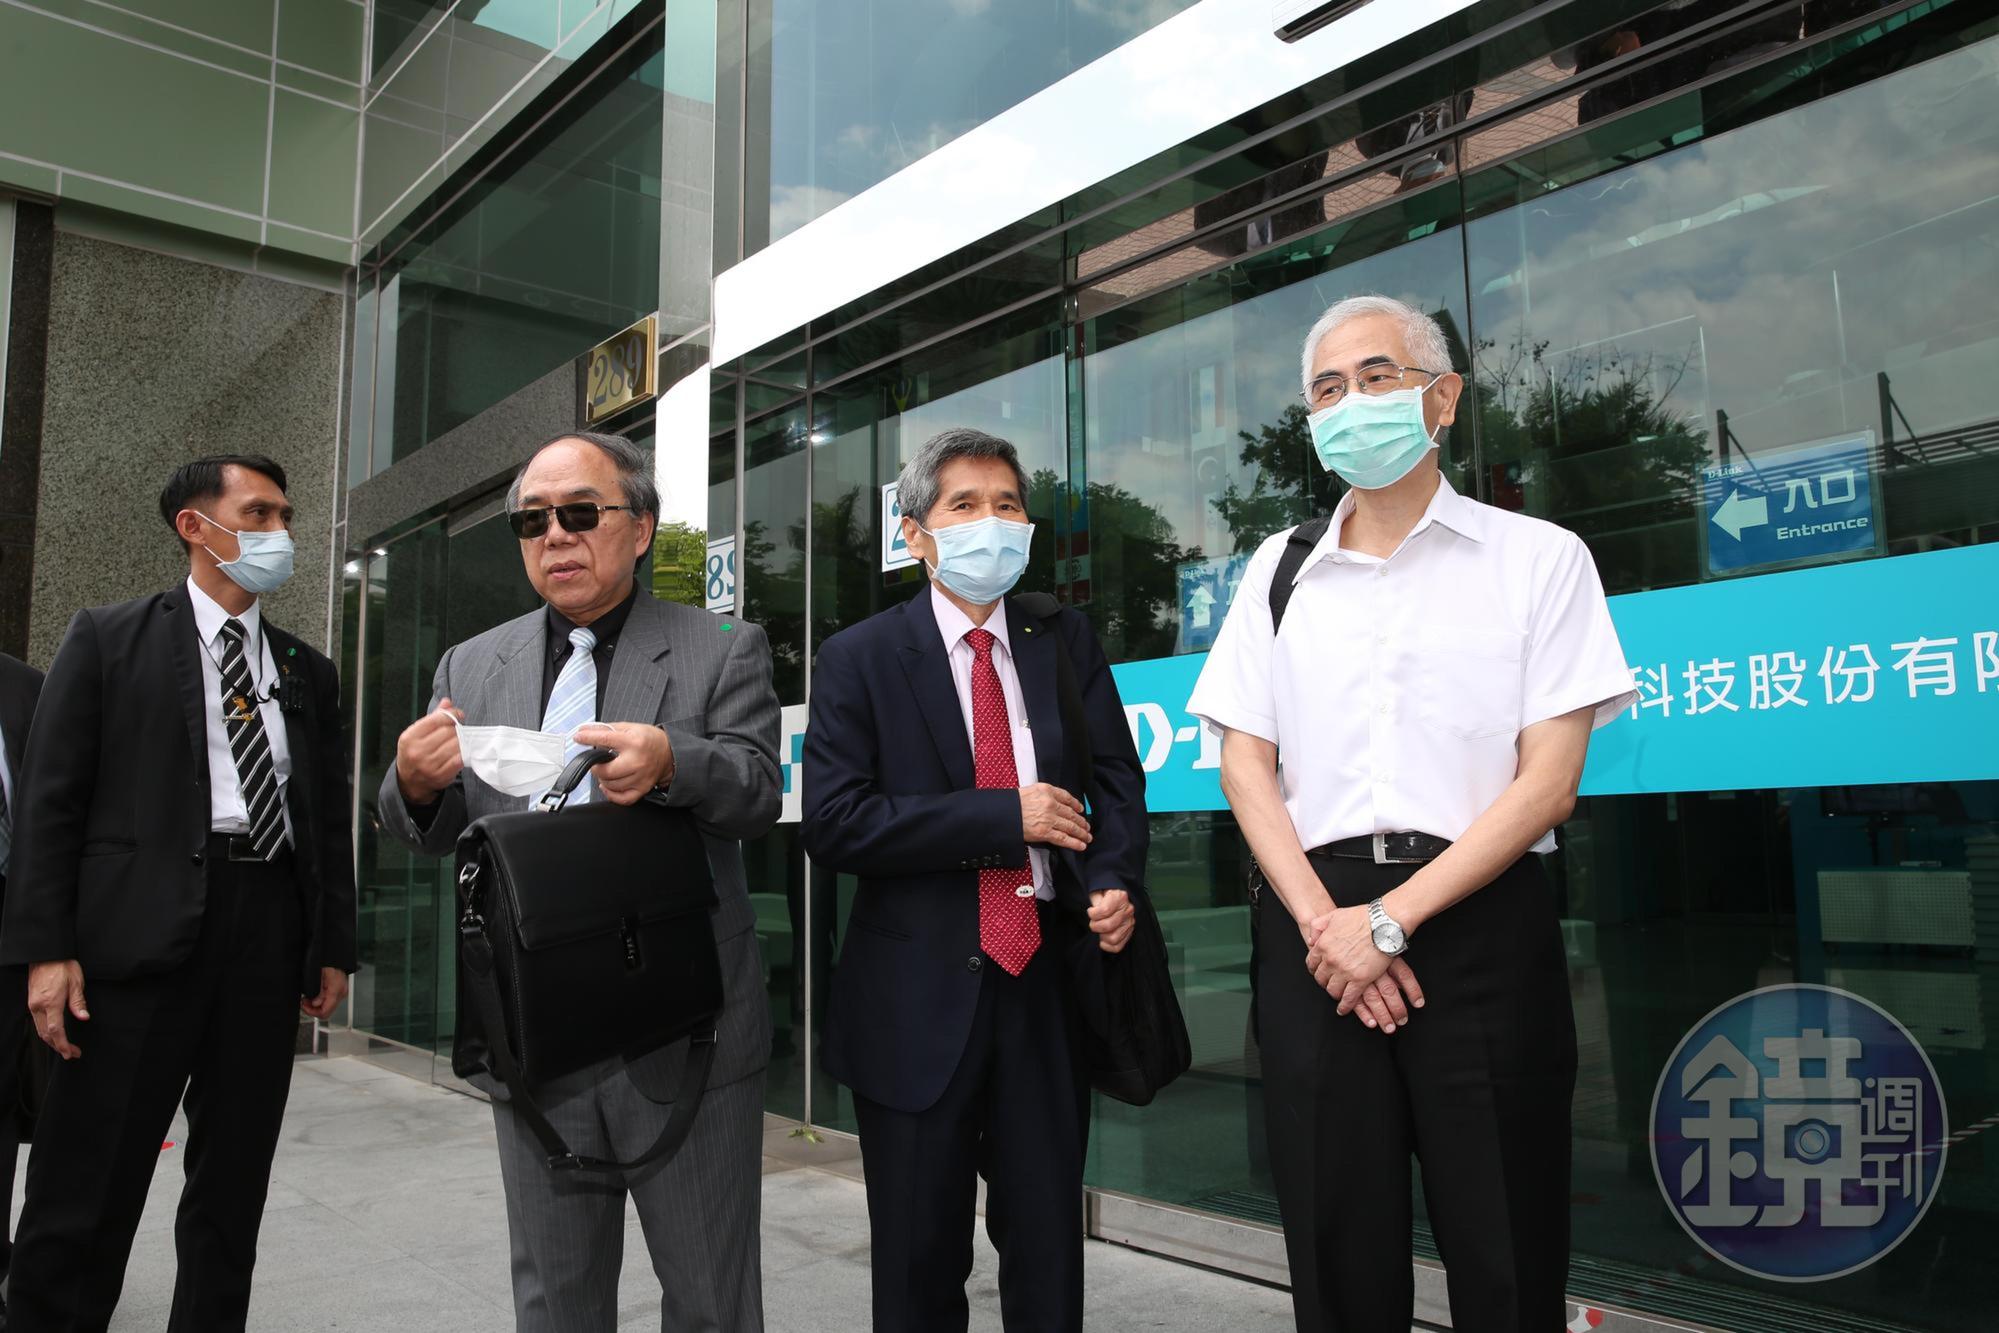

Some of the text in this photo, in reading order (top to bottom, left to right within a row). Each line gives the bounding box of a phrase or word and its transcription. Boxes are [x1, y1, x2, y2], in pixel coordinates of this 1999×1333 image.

[593, 335, 642, 408] 289
[1783, 470, 1856, 514] 入口
[1776, 517, 1869, 540] Entrance
